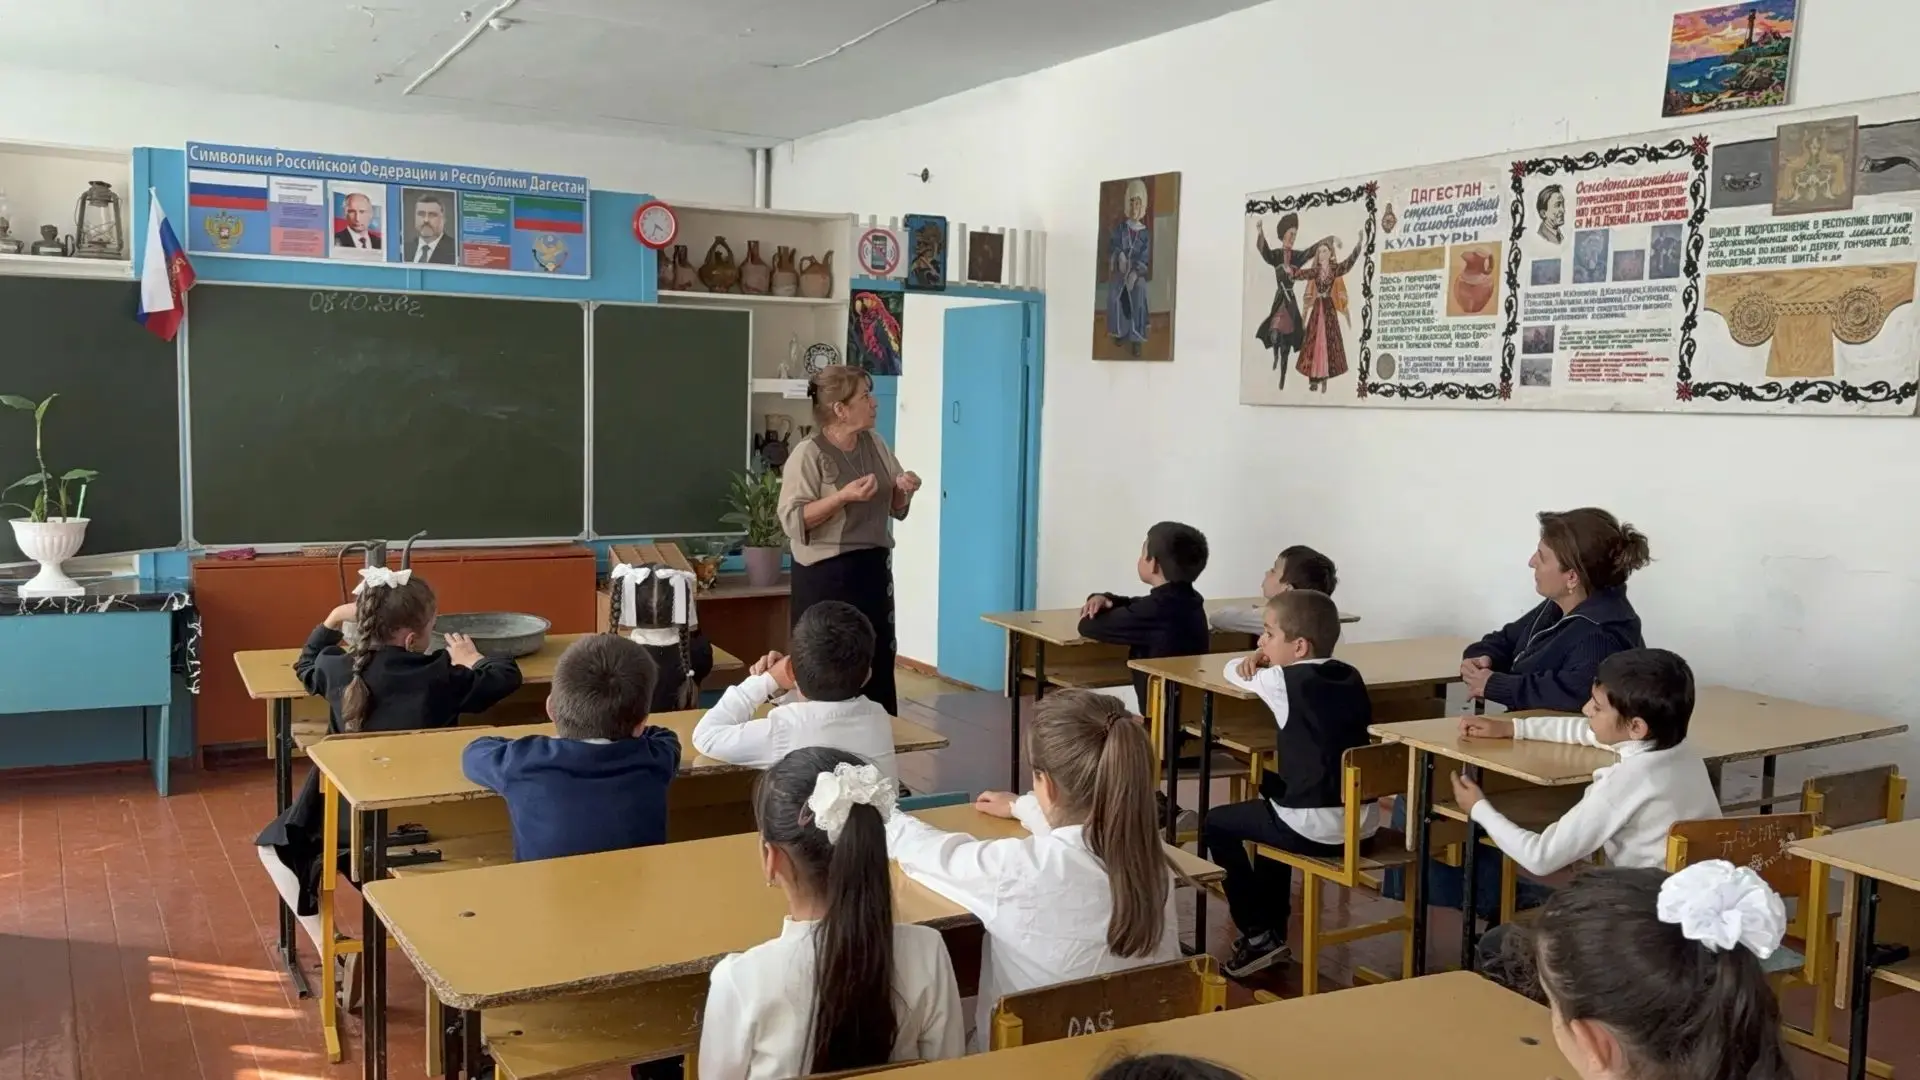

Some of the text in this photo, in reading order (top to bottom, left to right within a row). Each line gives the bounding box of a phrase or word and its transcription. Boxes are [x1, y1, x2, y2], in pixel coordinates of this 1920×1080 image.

[190, 145, 585, 194] Символики Российской Федерации и Республики Дагестан
[1410, 181, 1481, 205] ДАГЕСТАН
[1576, 170, 1689, 194] Основоположниками
[1404, 194, 1500, 219] страна древней
[1403, 211, 1498, 233] и самобытной
[1709, 212, 1913, 239] ШИРОКОЕ РАСПРОСТРАНЕНИЕ В РЕСПУБЛИКЕ ПОЛУЧИЛИ
[1385, 231, 1479, 250] КУЛЬТУРЫ
[1729, 247, 1756, 257] РЕЗЬБА
[1758, 246, 1769, 255] ПО
[1770, 244, 1798, 254] КАМНЮ
[1844, 237, 1887, 249] ГОНЧАРНОЕ
